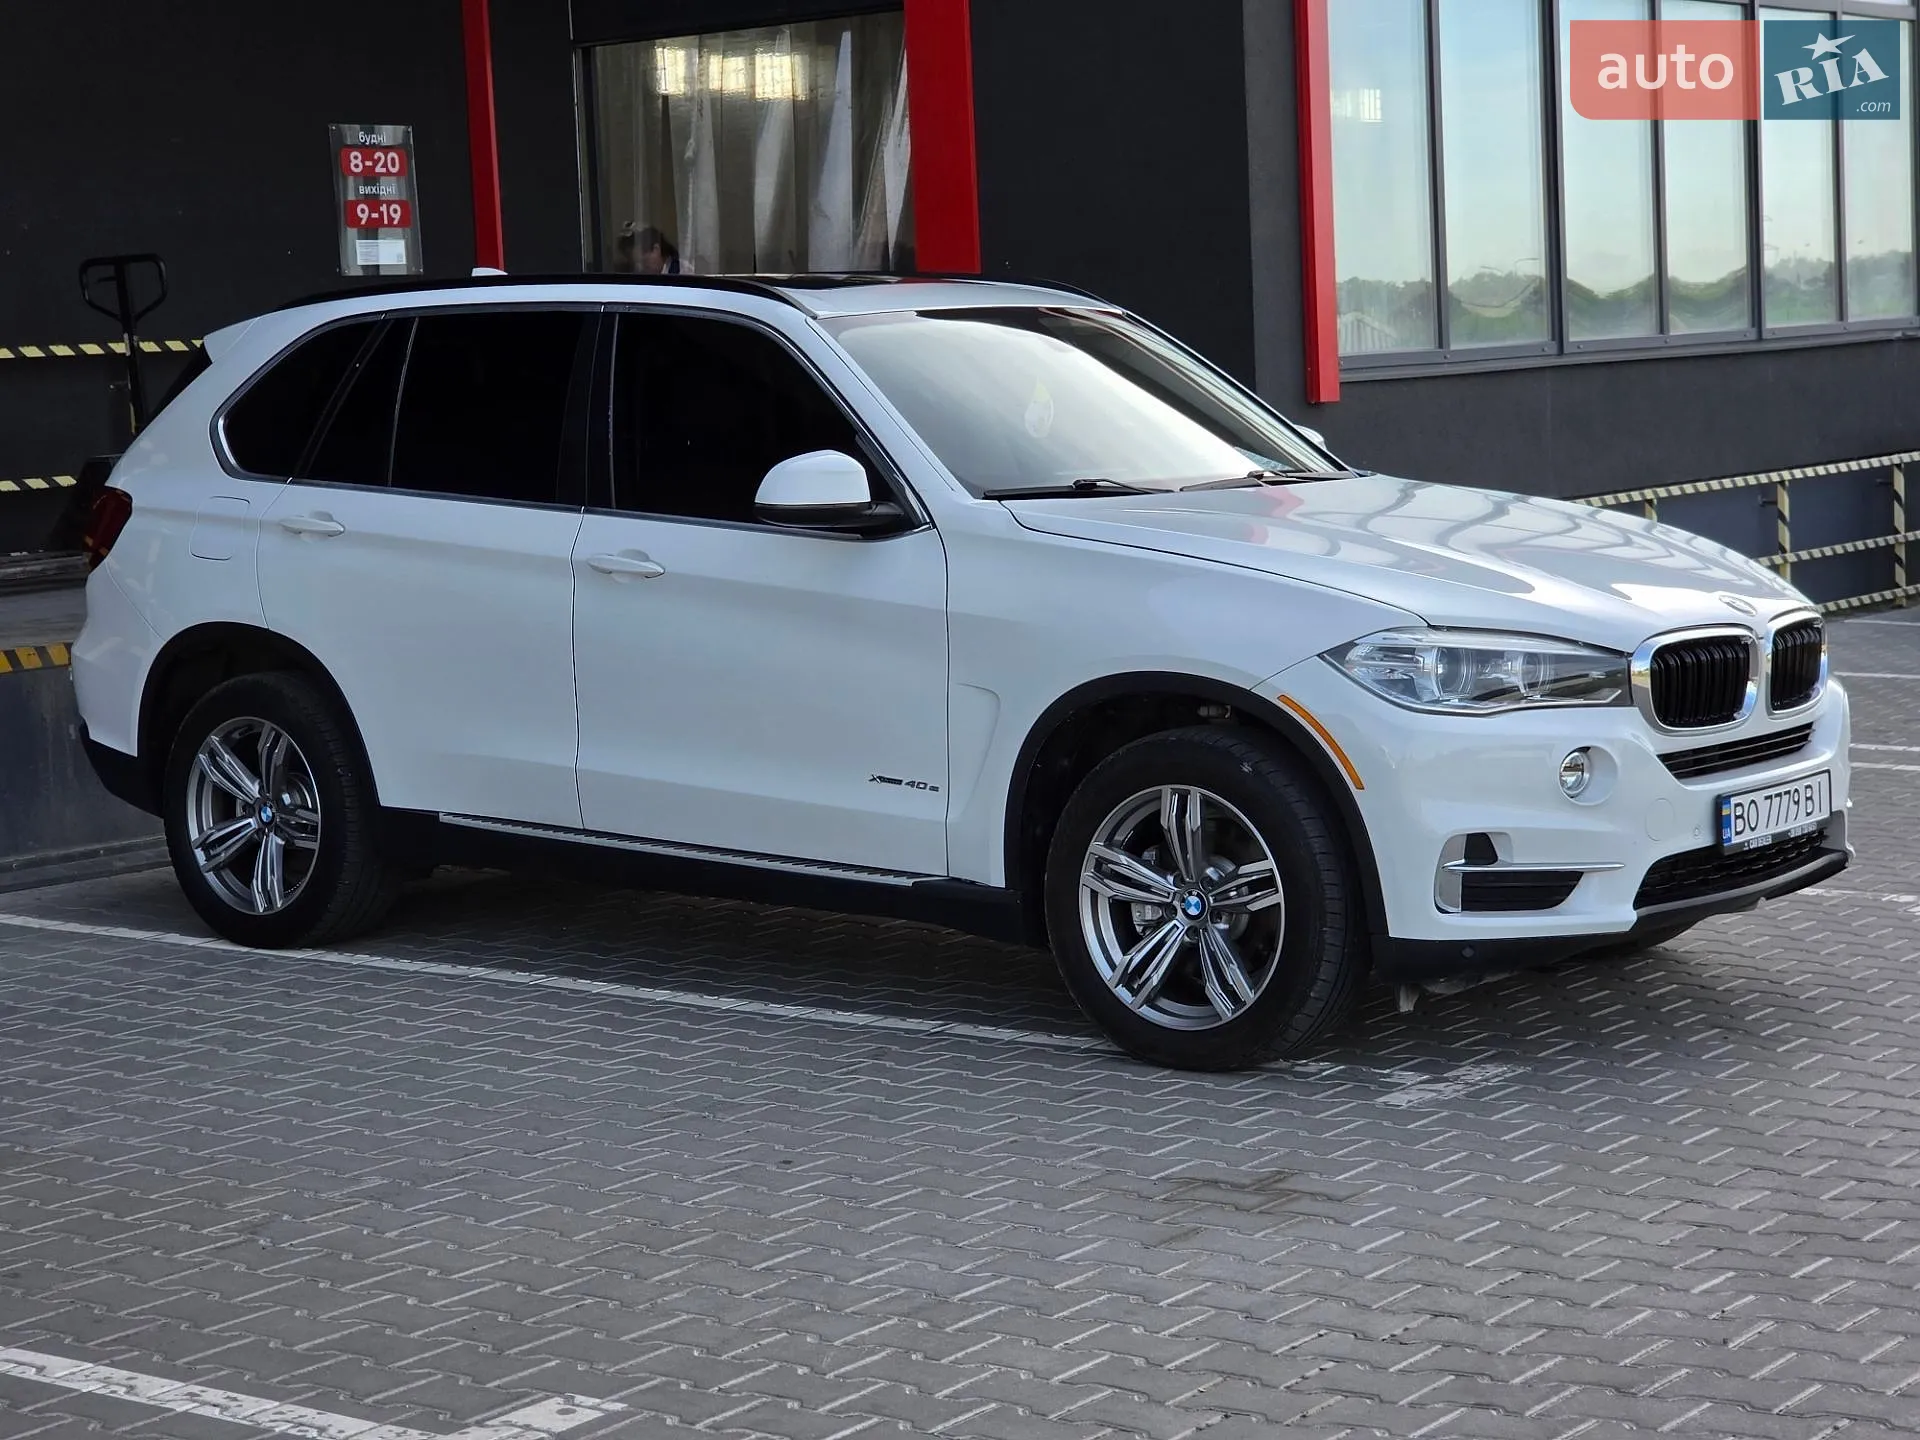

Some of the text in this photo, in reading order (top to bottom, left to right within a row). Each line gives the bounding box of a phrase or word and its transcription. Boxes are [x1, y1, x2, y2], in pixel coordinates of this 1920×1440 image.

[358, 131, 386, 145] будні
[350, 151, 400, 173] 8-20
[358, 184, 396, 196] вихідні
[356, 203, 402, 225] 9-19
[1733, 799, 1759, 836] BO
[1764, 787, 1801, 829] 7779
[1804, 780, 1822, 817] BI
[1722, 828, 1731, 840] UA
